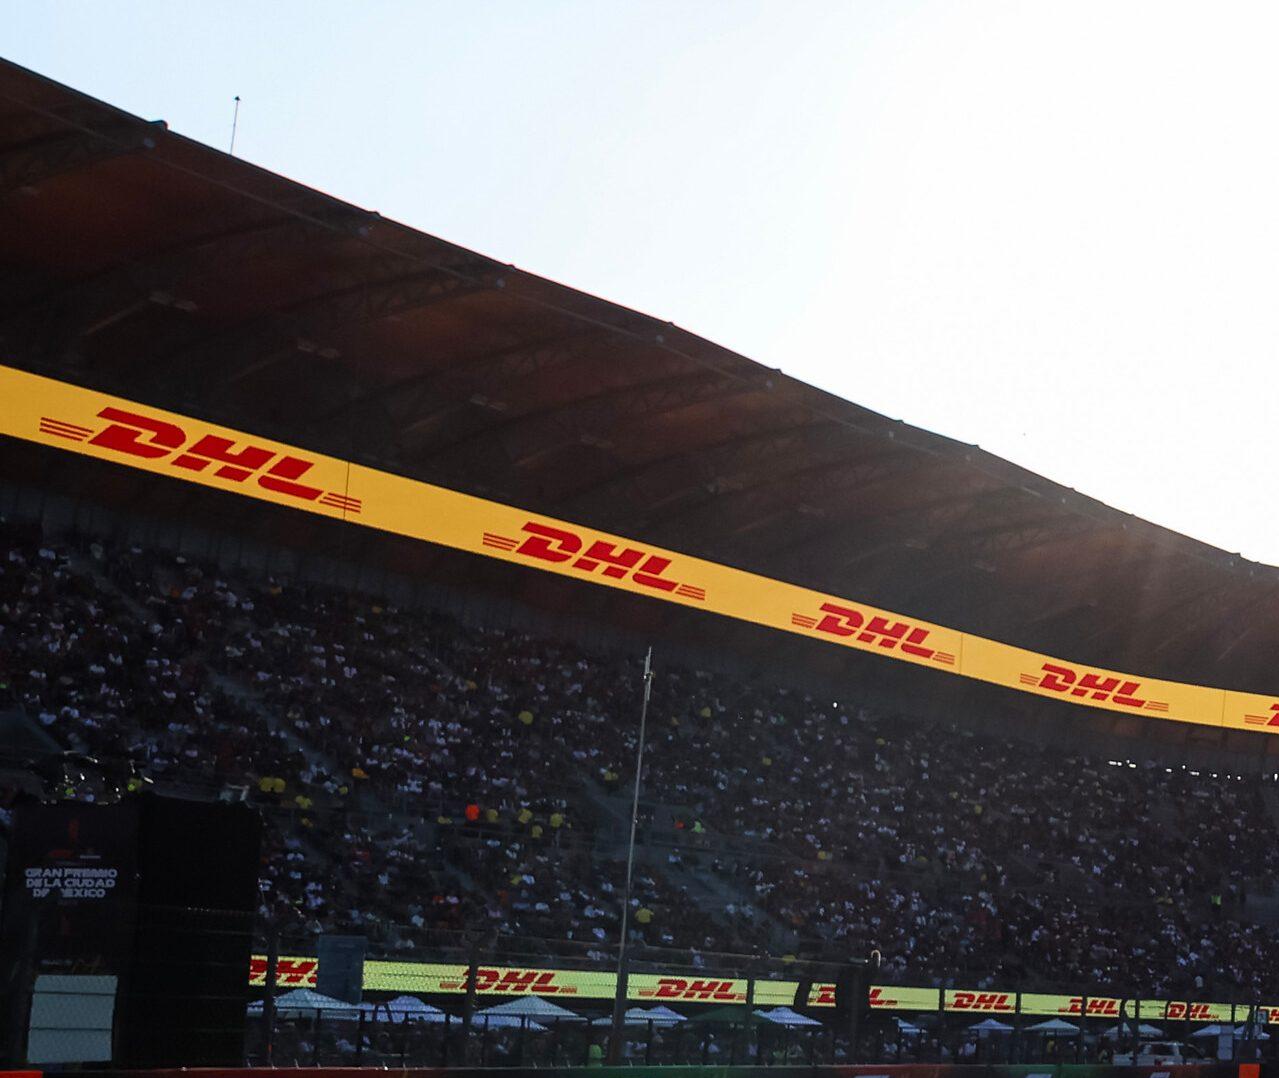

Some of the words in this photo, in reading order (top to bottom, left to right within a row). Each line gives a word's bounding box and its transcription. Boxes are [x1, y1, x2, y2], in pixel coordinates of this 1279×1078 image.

[88, 407, 325, 501] DHL
[516, 521, 679, 593] DHL
[815, 602, 935, 659] DHL
[1038, 663, 1146, 708] DHL
[61, 889, 106, 898] EXICO
[462, 970, 560, 993] DHL
[657, 979, 737, 999] DHL
[953, 993, 1012, 1010] DHL
[1069, 999, 1119, 1015] DHL
[1169, 1003, 1212, 1019] DHL
